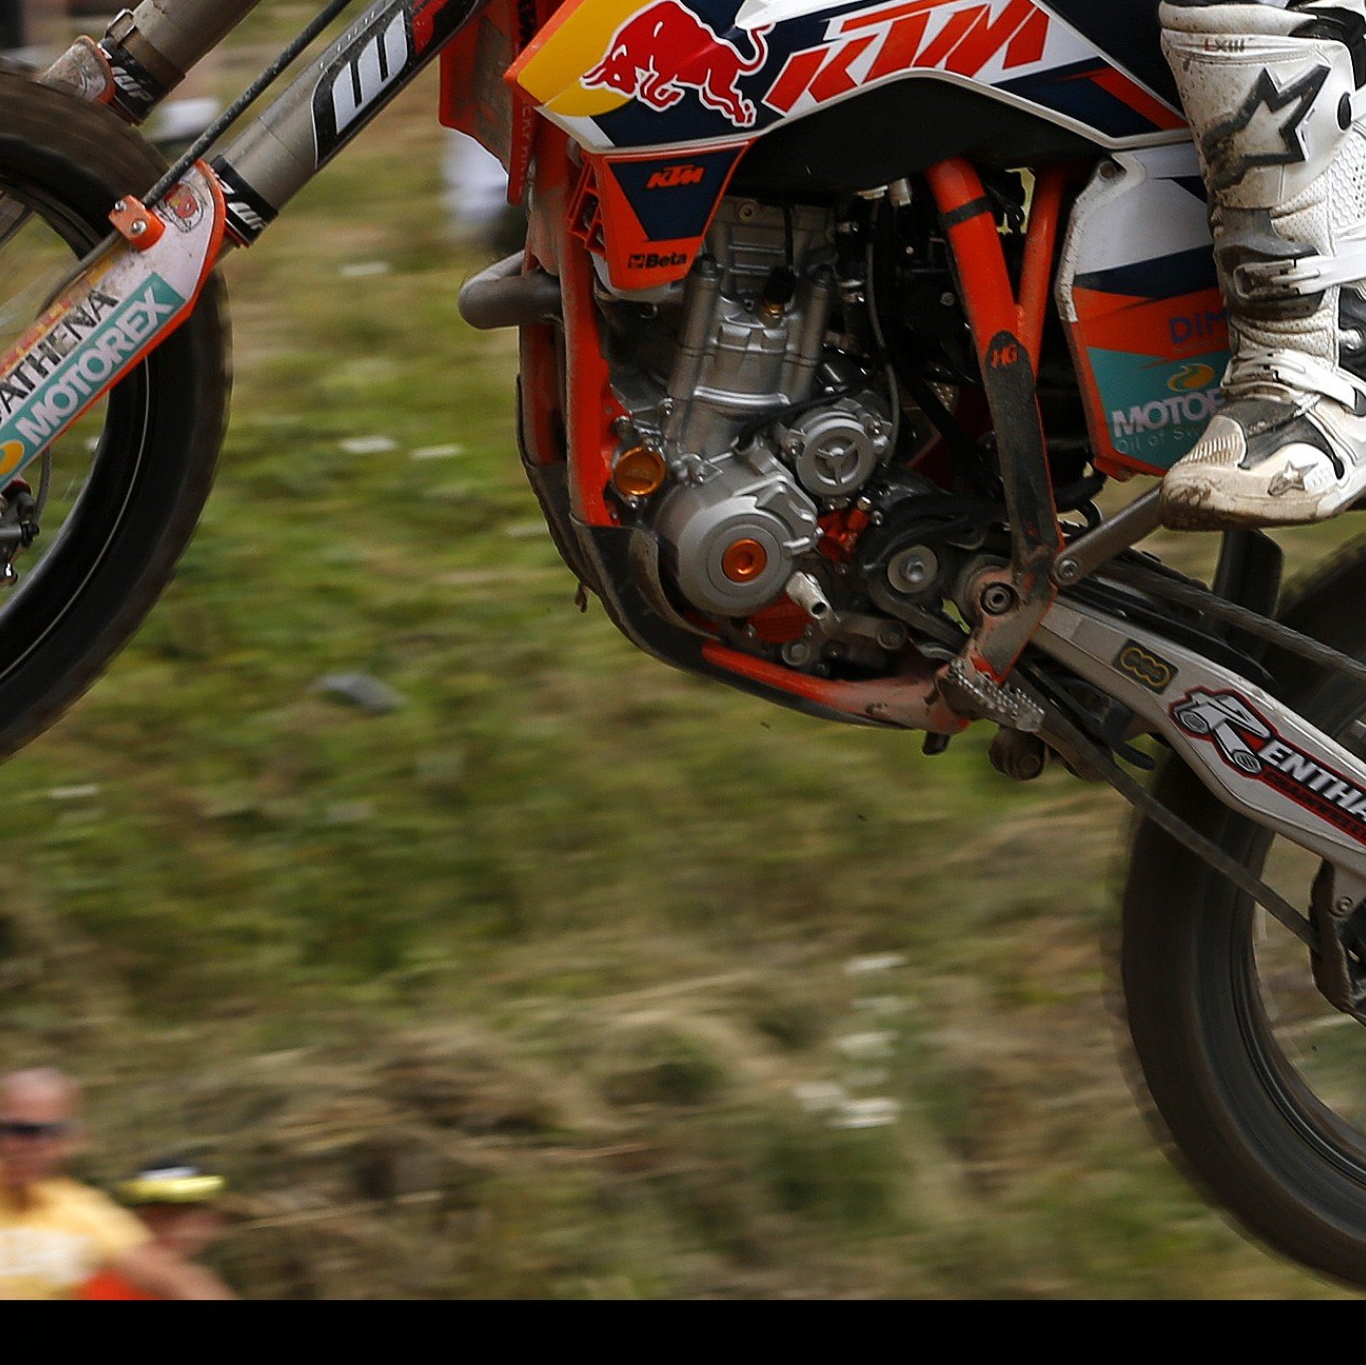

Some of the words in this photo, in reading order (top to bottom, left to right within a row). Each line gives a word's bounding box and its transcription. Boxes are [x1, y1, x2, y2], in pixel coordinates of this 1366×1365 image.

[646, 164, 705, 189] KTM
[646, 252, 688, 269] Beta
[15, 286, 175, 446] MOTOREX
